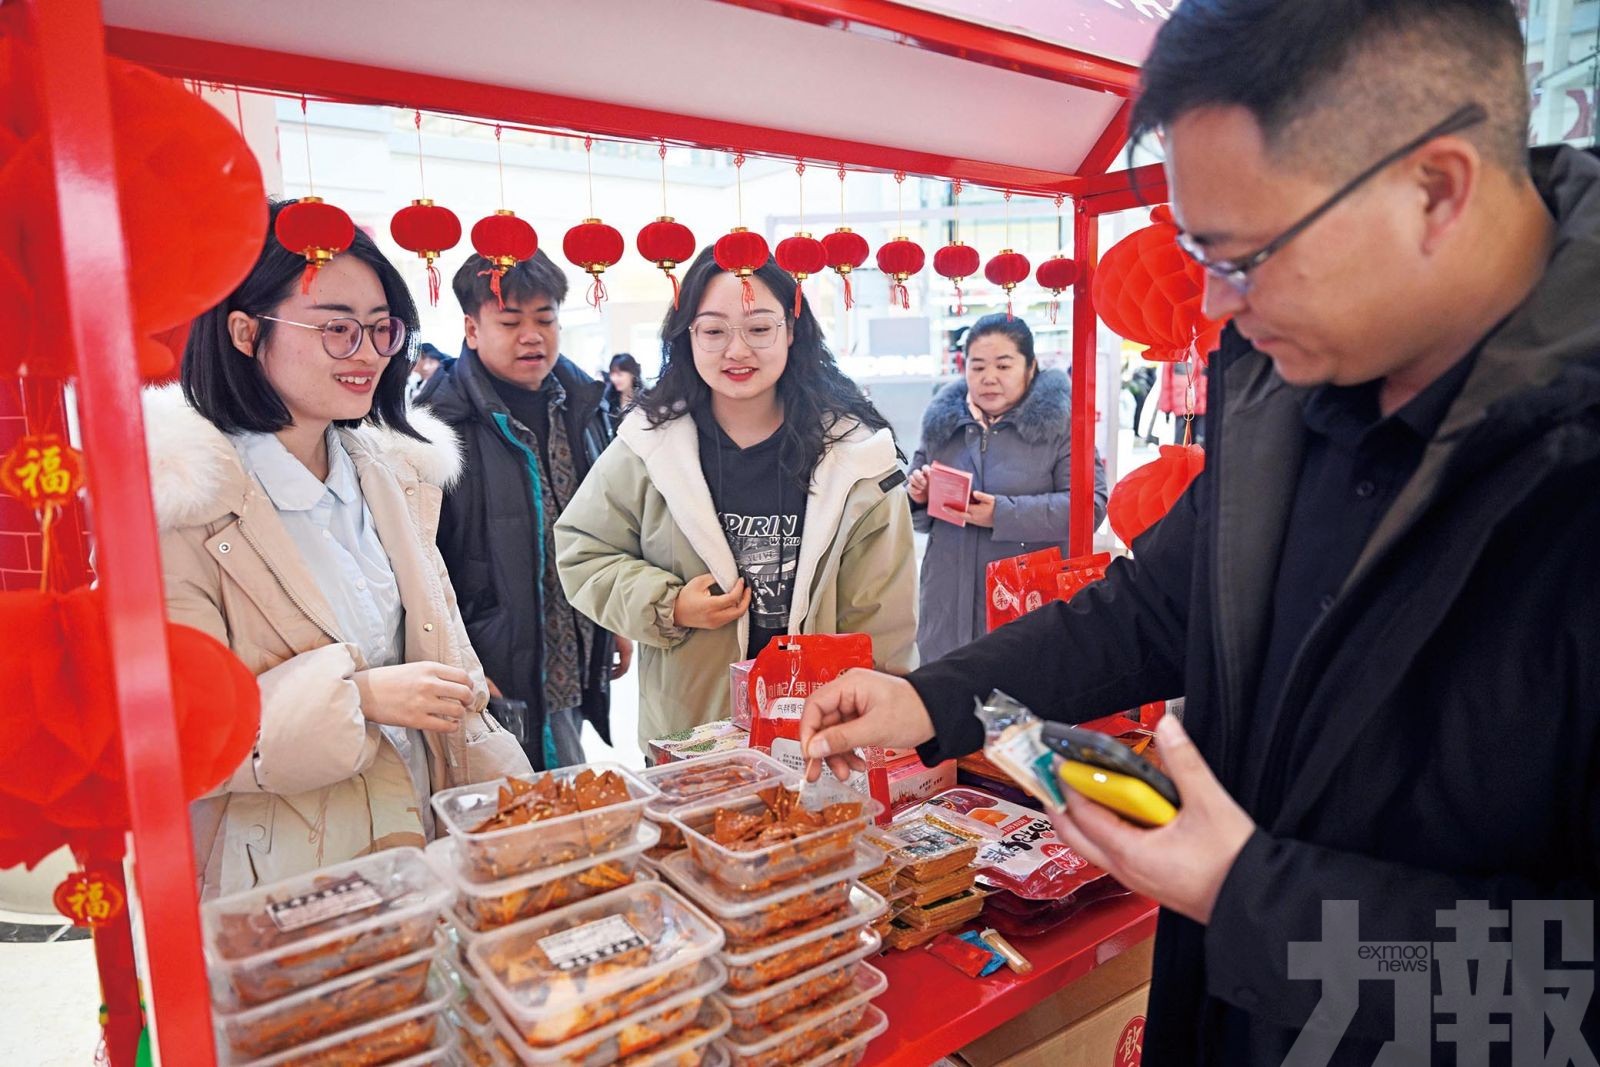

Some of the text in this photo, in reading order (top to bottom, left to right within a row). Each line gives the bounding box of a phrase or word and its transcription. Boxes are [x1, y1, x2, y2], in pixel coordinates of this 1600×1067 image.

[15, 446, 70, 497] 福
[768, 536, 800, 546] WRLD
[67, 882, 110, 919] 福
